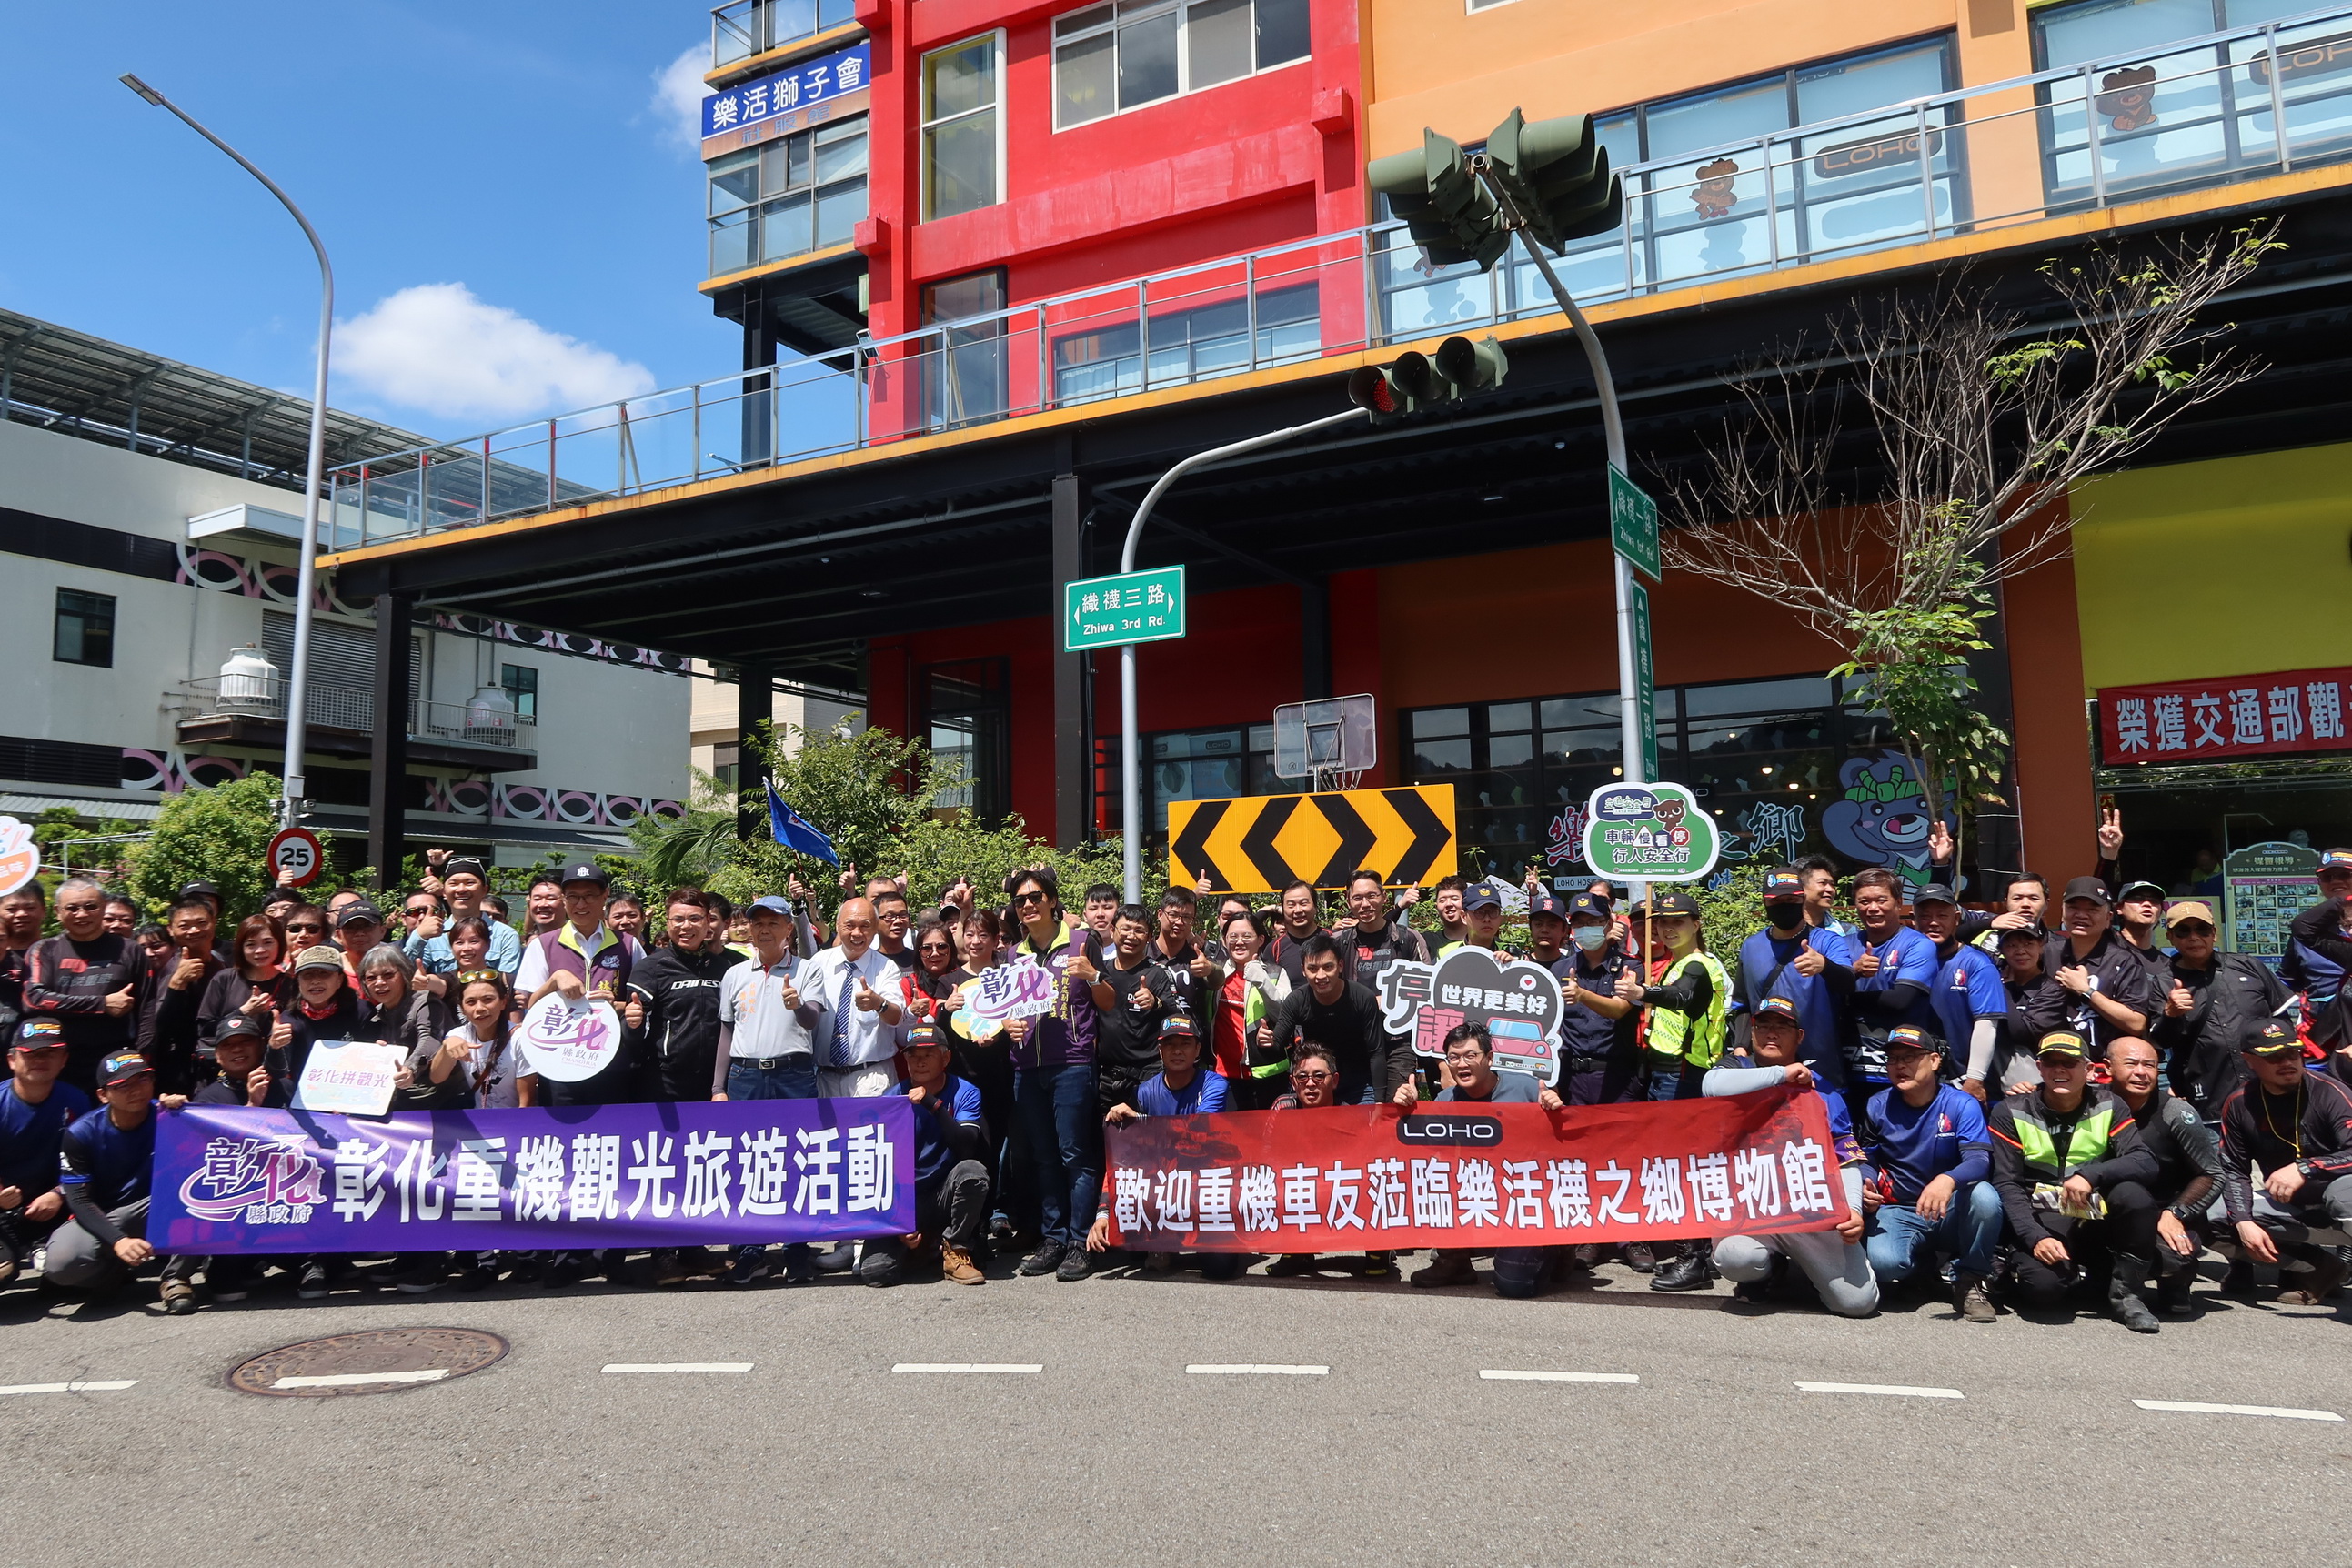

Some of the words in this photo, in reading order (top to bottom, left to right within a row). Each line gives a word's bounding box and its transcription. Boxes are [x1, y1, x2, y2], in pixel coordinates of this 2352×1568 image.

[712, 56, 863, 130] 樂活獅子會
[742, 104, 831, 144] 社服館
[1081, 583, 1166, 614] 織襪三路
[1082, 622, 1115, 635] Zhiwa
[1121, 618, 1141, 630] 3rd
[1148, 615, 1166, 627] Rd.
[2116, 680, 2352, 754] 榮獲交通部觀
[1604, 827, 1688, 847] 車輛慢看停
[280, 847, 309, 867] 25
[1613, 848, 1691, 863] 行人安全行
[1556, 879, 1575, 888] LOHO
[670, 979, 720, 990] DAINES
[980, 966, 1049, 1005] 彰化
[1014, 1001, 1050, 1017] 縣政府
[1442, 984, 1548, 1016] 世界更美好
[541, 1003, 606, 1050] 彰化
[562, 1047, 599, 1061] 縣政府
[307, 1068, 389, 1088] 彰化拼觀光
[1403, 1122, 1494, 1139] LOHO
[204, 1136, 313, 1206] 彰化
[332, 1122, 895, 1224] 彰化重機觀光旅遊活動
[1114, 1137, 1834, 1233] 歡迎重機車友蒞臨樂活襪之鄉博物館
[246, 1204, 312, 1225] 縣政府
